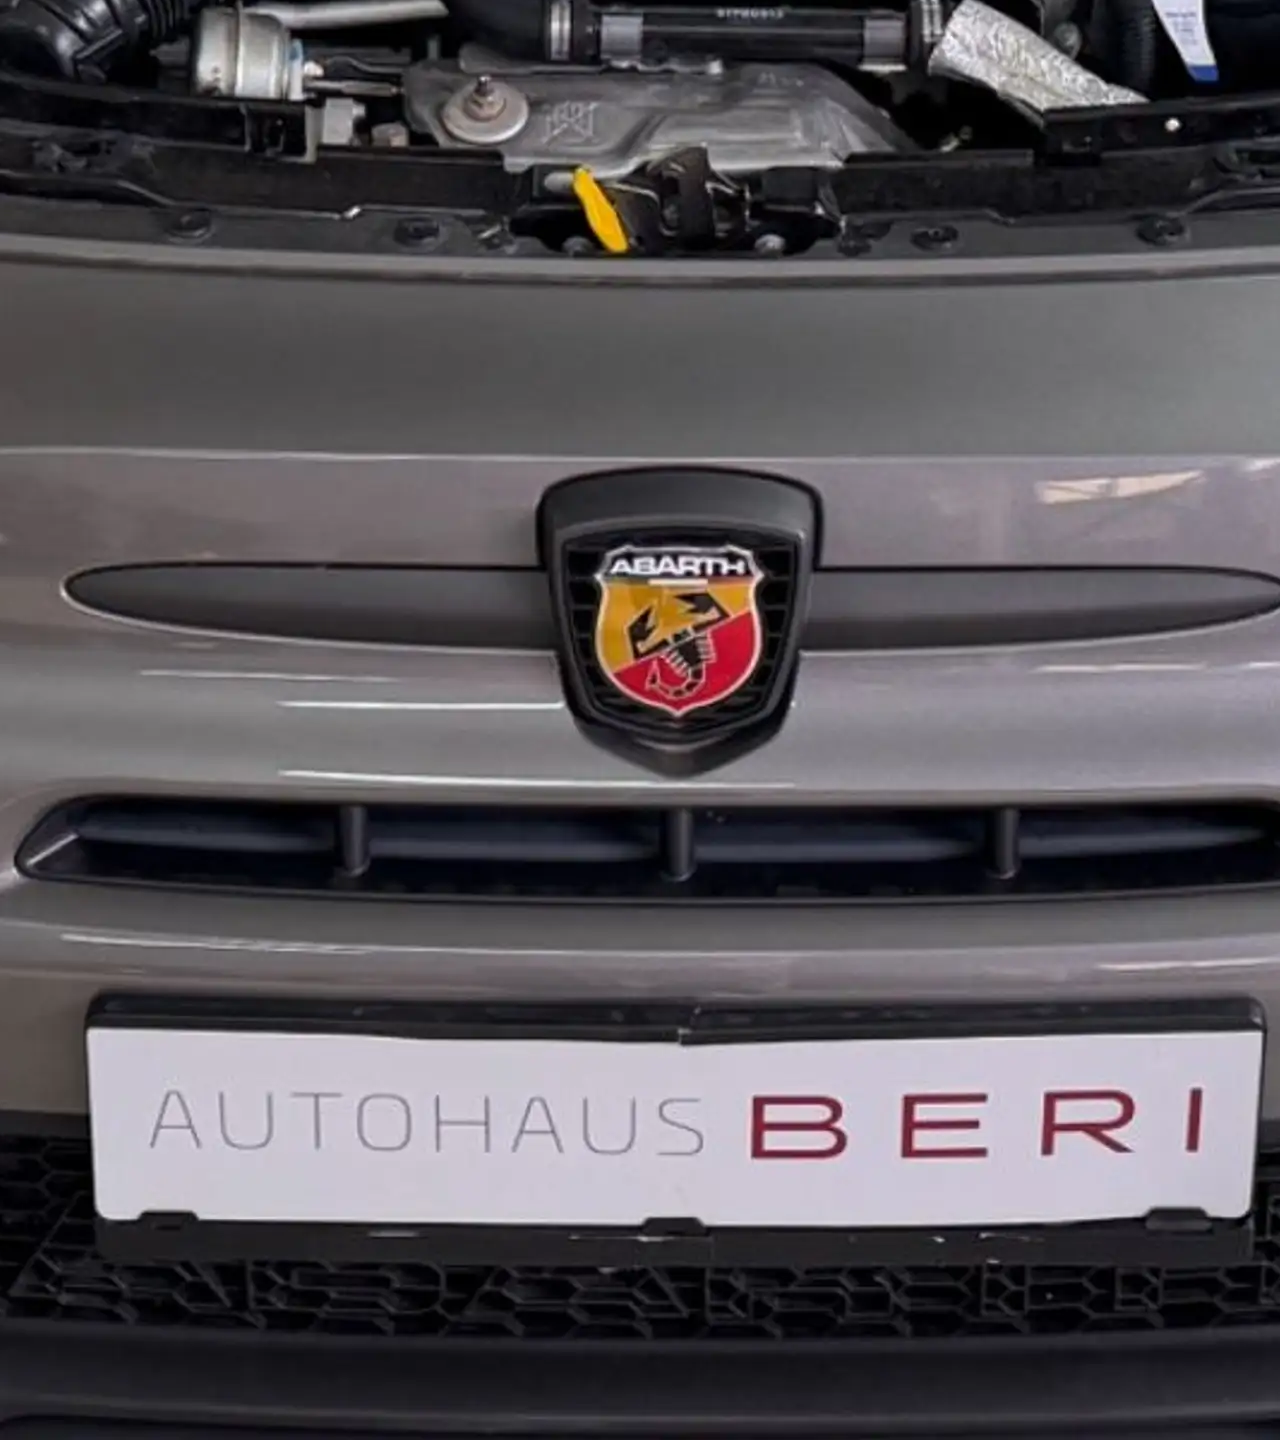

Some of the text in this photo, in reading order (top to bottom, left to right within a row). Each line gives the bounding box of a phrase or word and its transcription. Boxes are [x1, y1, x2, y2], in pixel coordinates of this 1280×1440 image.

[610, 556, 746, 575] ABARTH
[148, 1088, 1204, 1160] AUTOHAUS BERI
